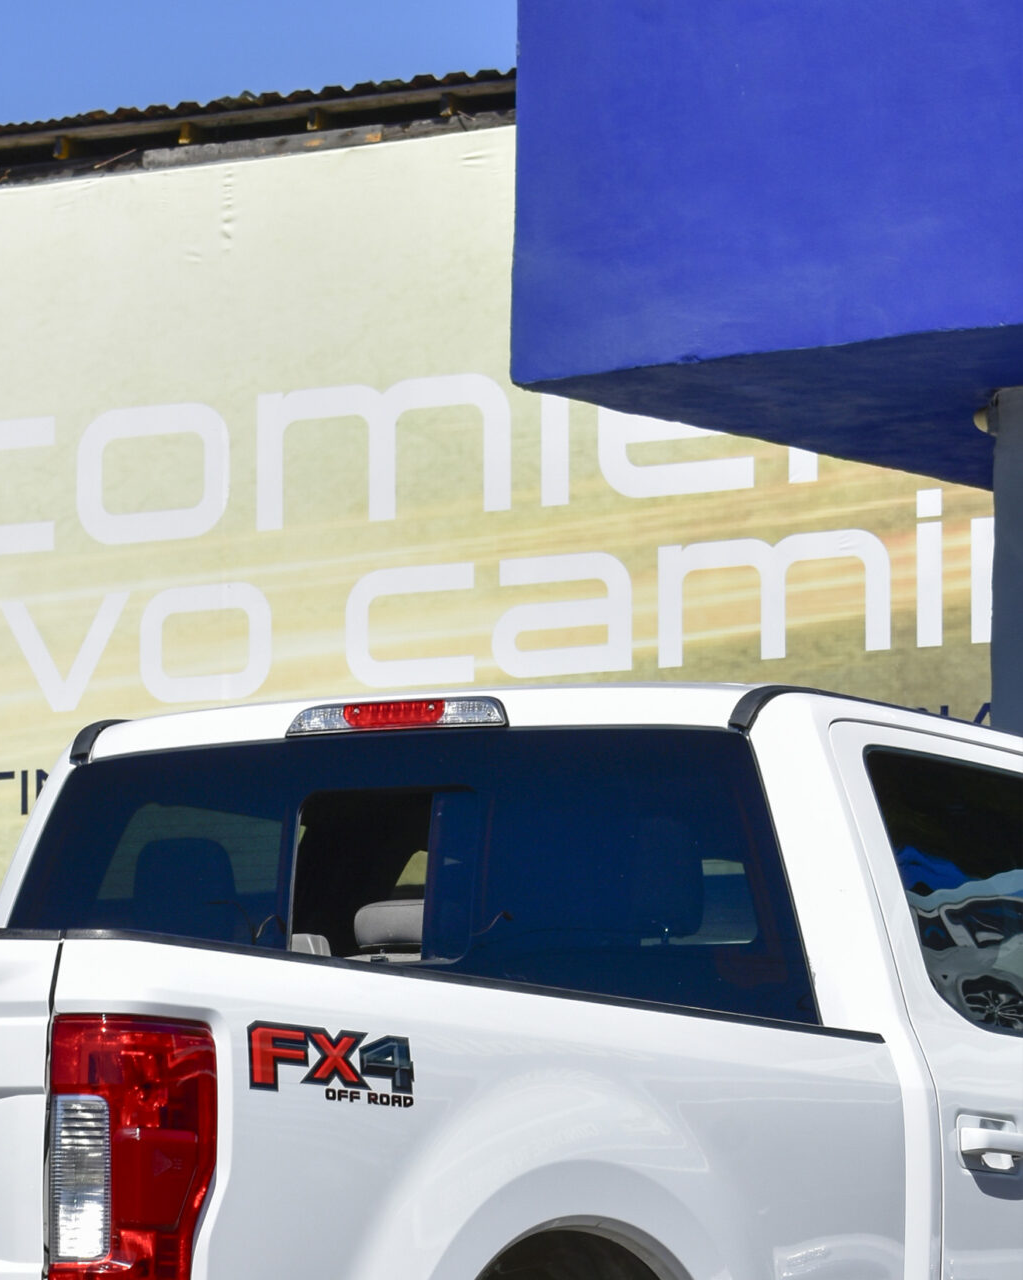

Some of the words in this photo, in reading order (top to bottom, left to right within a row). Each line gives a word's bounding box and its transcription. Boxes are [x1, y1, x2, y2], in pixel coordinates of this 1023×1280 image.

[344, 488, 994, 684] cami
[247, 1020, 415, 1094] FX4
[325, 1088, 360, 1103] OFF
[367, 1092, 414, 1108] ROAD
